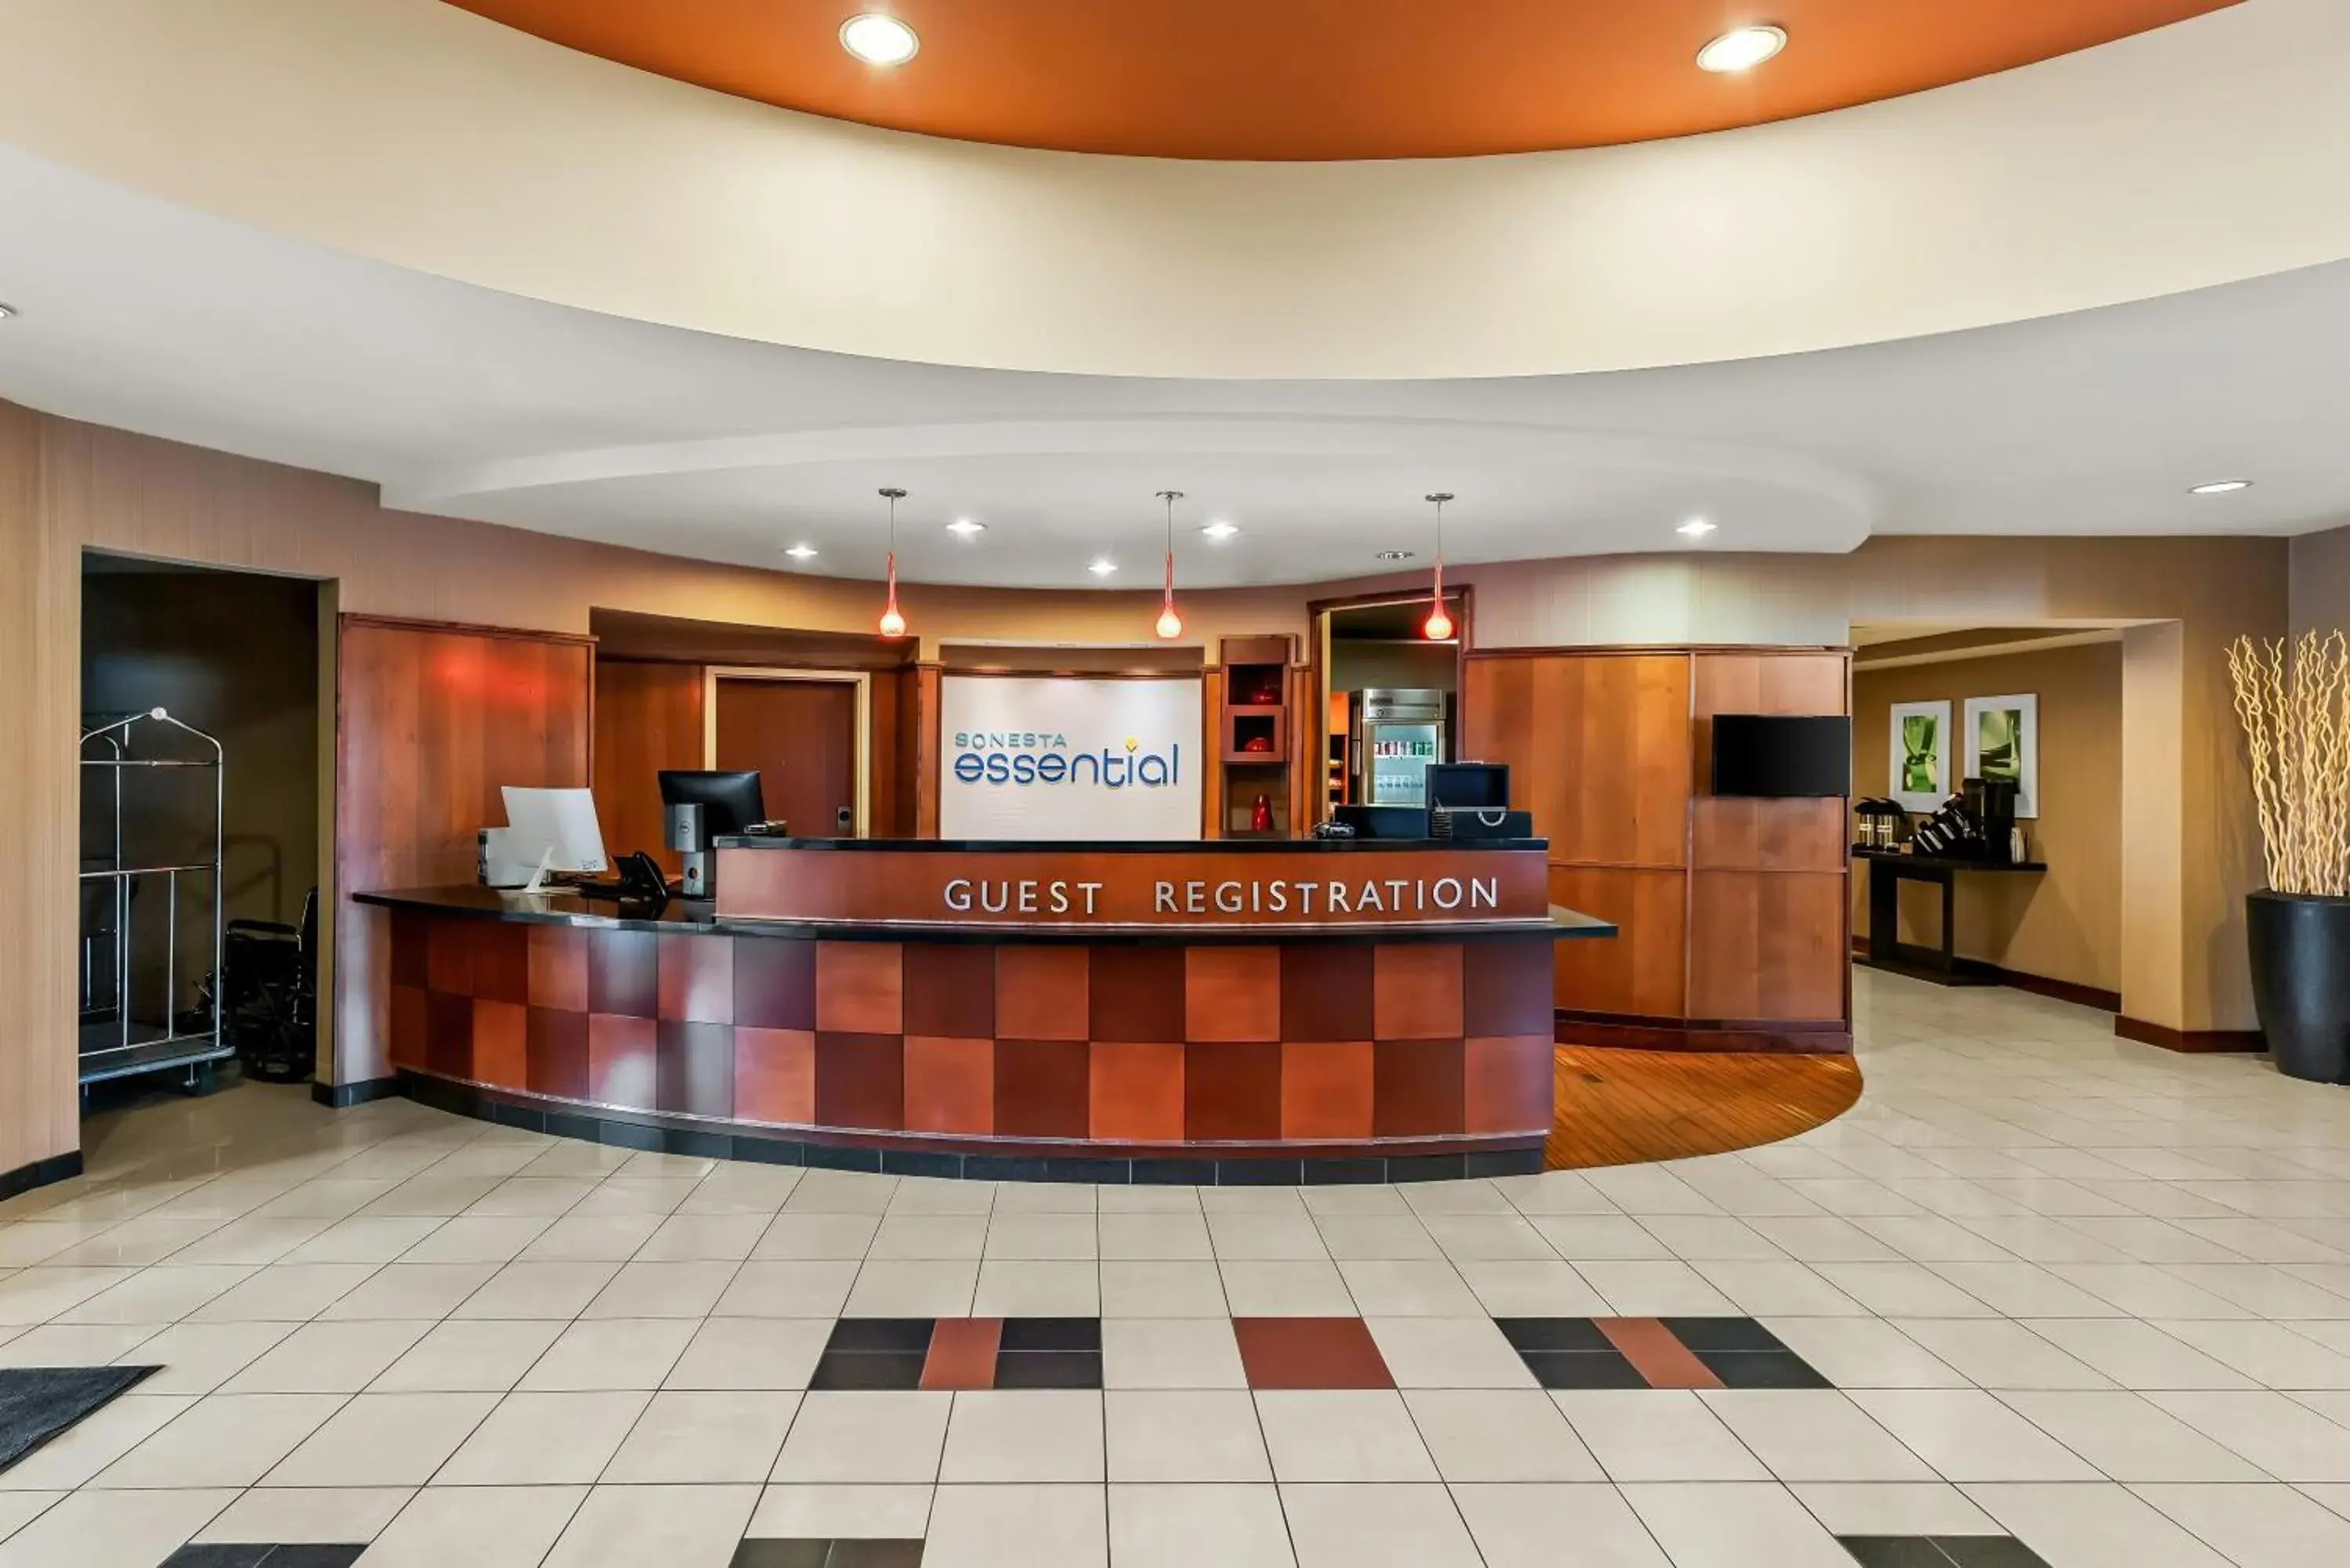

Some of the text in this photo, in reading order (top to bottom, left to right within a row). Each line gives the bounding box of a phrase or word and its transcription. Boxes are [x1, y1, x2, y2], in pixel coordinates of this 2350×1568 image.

[954, 732, 1067, 750] SONESTA
[954, 735, 1179, 788] essential
[943, 876, 1499, 915] GUEST REGISTRATION
